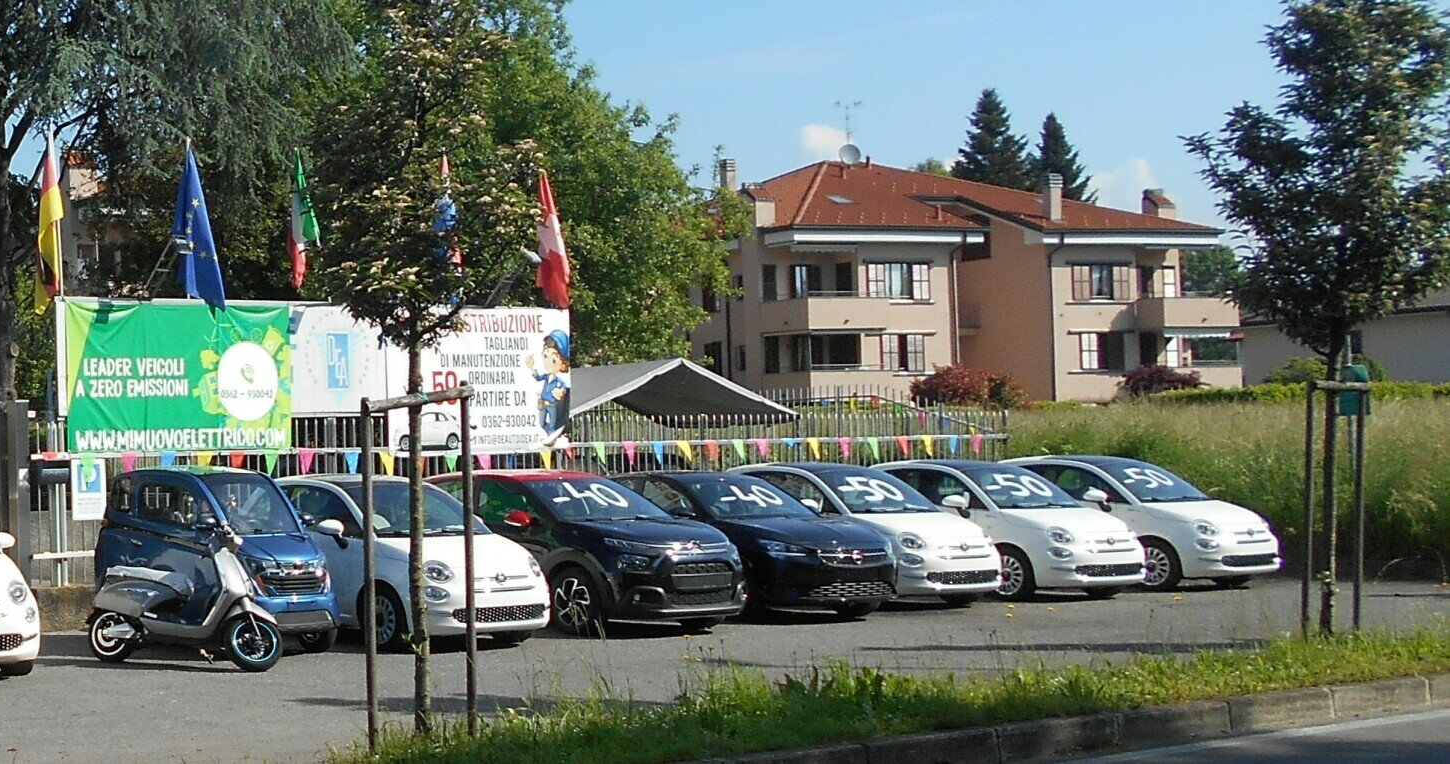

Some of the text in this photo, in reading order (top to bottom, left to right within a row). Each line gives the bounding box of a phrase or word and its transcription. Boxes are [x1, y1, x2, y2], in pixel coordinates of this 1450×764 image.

[456, 313, 544, 333] STRIBUZIONE
[484, 336, 529, 351] TAGLIANDI
[83, 357, 185, 377] LEADER VEICOLI
[440, 354, 521, 368] DI MANUTENZIONE
[468, 371, 516, 385] ORDINARIA
[75, 379, 189, 398] A ZERO EMISSIONI
[220, 389, 238, 399] 0362
[247, 389, 274, 399] 930042
[469, 390, 527, 407] PARTIRE DA
[481, 414, 537, 428] 0362-930042
[75, 428, 287, 451] WWW.MIMUOVOELETTRICO.COM
[478, 433, 540, 446] INFO@DEAUTOIDEA.IT
[985, 473, 1054, 498] -50
[1123, 467, 1175, 490] -50
[552, 481, 629, 515] -40
[720, 484, 784, 508] -40
[837, 476, 906, 502] -50
